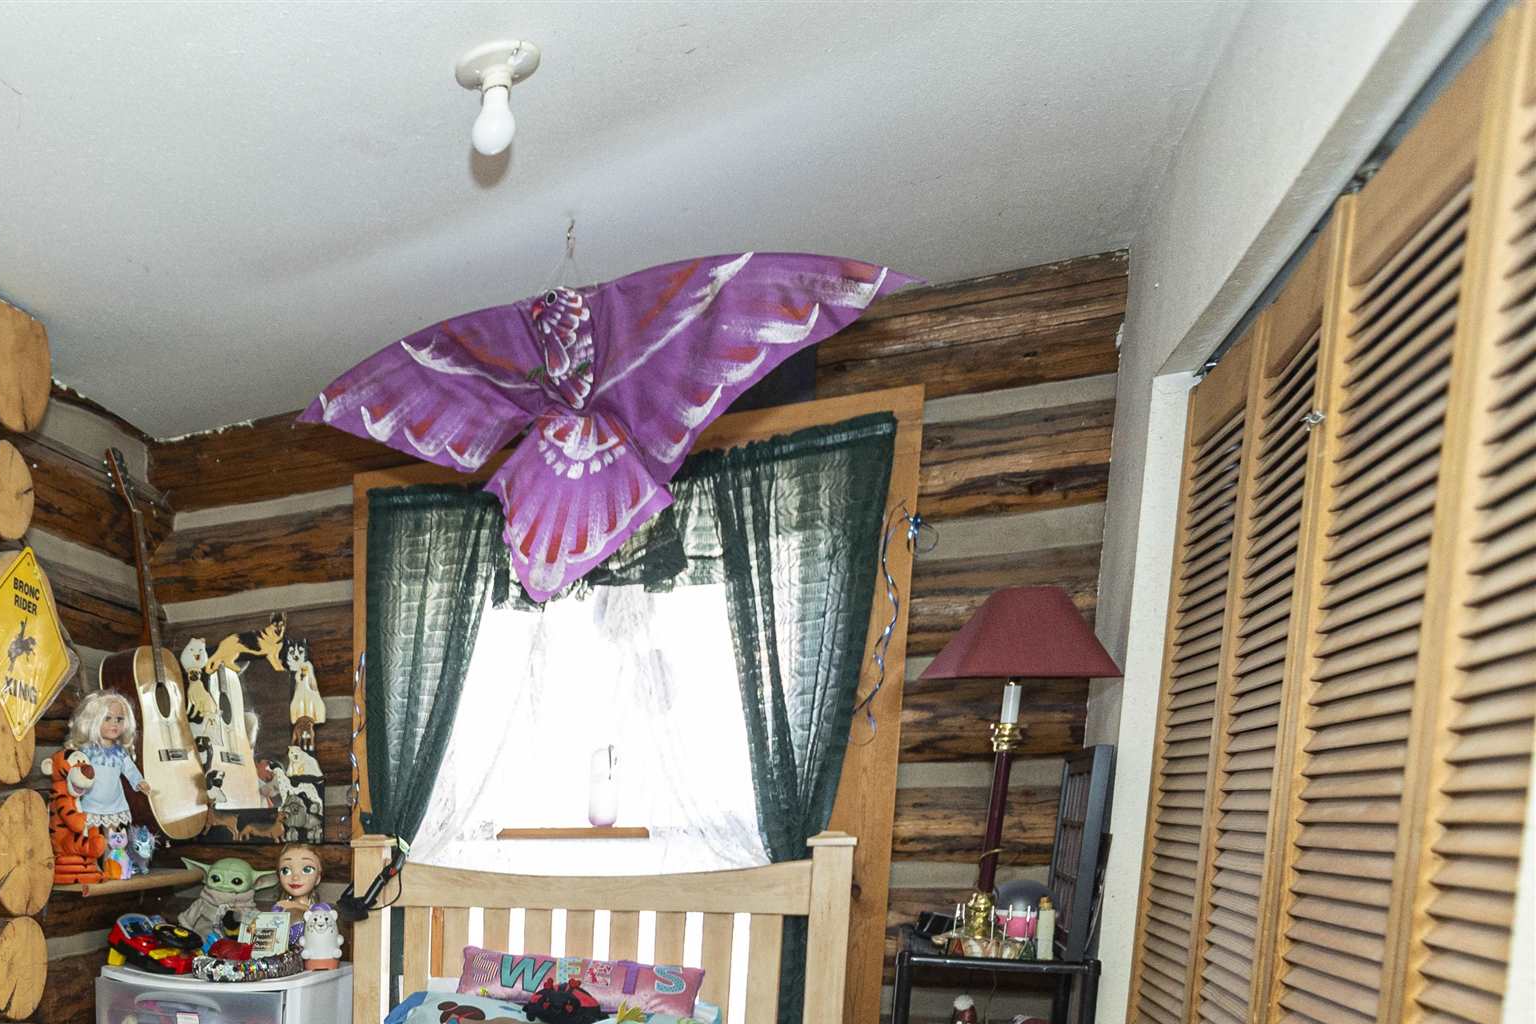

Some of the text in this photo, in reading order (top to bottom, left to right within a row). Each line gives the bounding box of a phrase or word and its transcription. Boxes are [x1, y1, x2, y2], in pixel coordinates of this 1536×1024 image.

[13, 577, 40, 601] BRONC
[14, 594, 38, 615] RIDER
[472, 951, 686, 994] SWEETS
